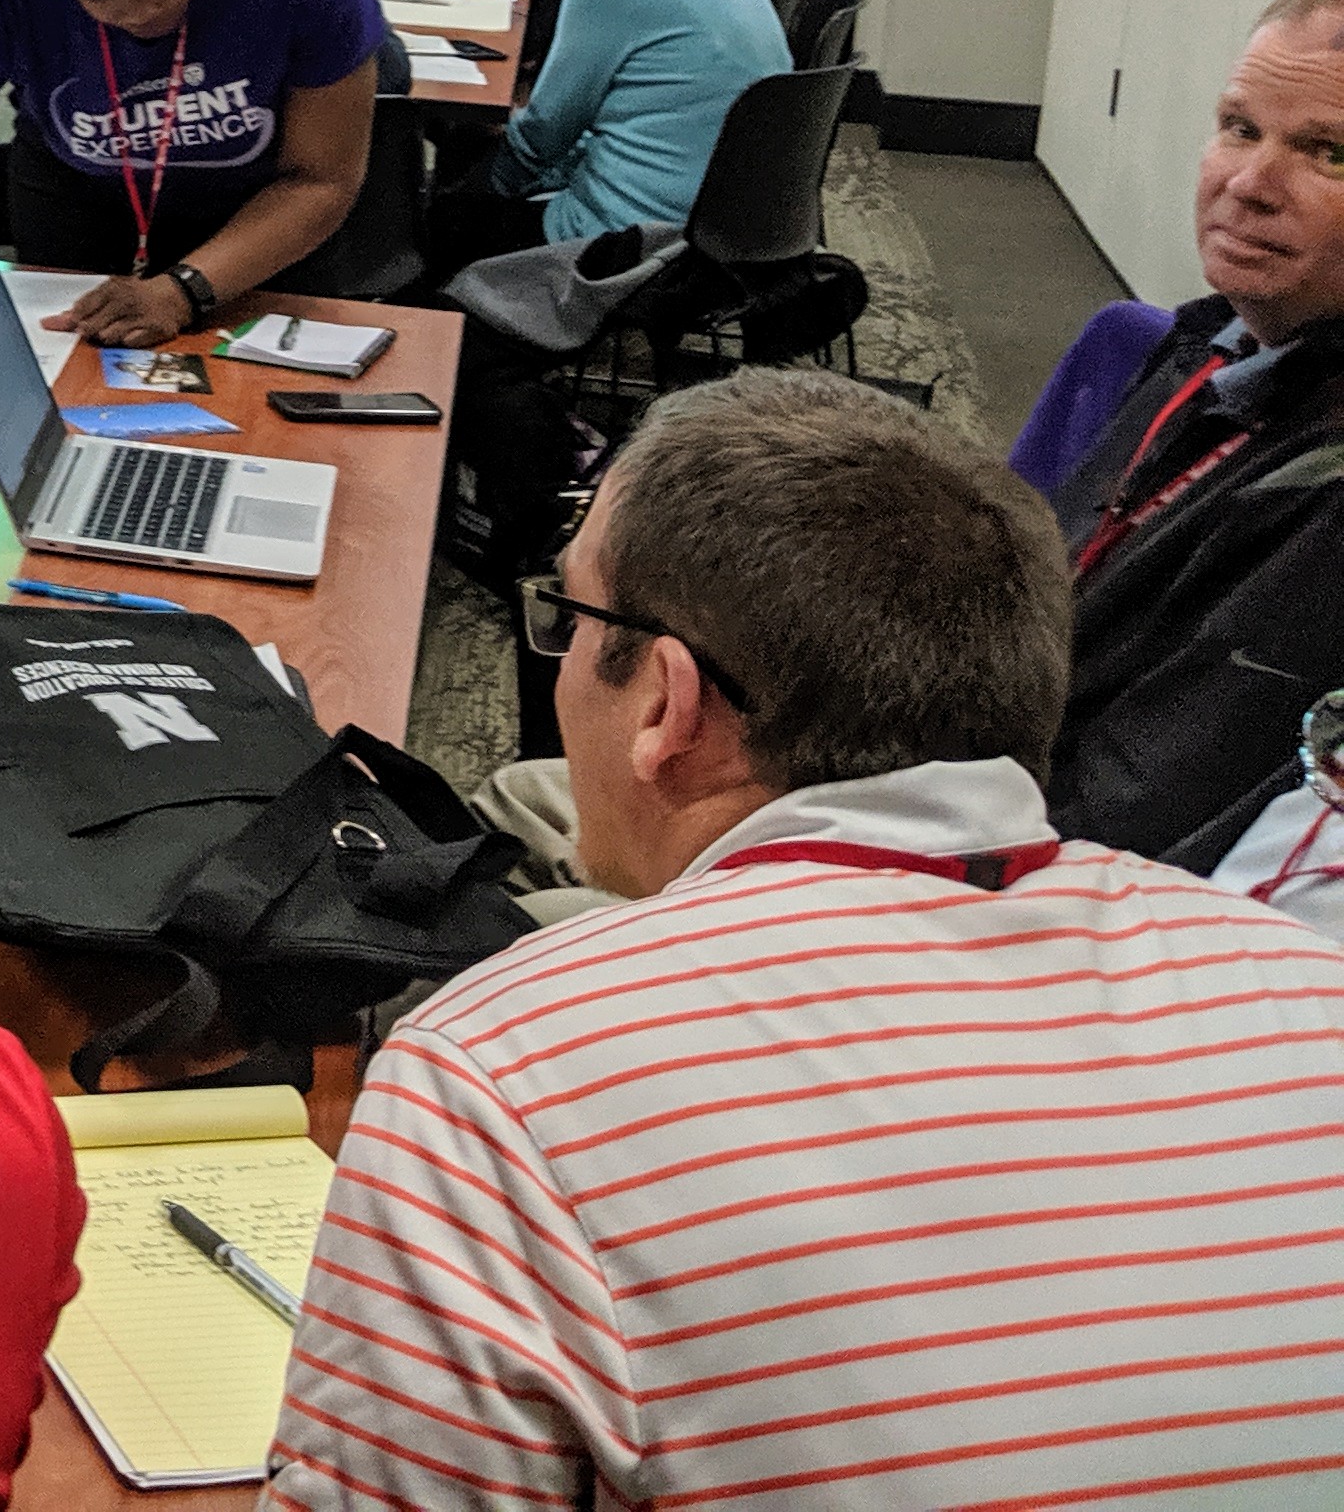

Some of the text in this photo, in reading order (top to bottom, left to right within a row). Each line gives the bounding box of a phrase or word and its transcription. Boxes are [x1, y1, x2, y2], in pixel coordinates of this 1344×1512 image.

[72, 78, 251, 138] STUDENT
[11, 659, 100, 683] SCIENCES
[19, 673, 121, 703] EDUCATION
[82, 691, 221, 751] N
